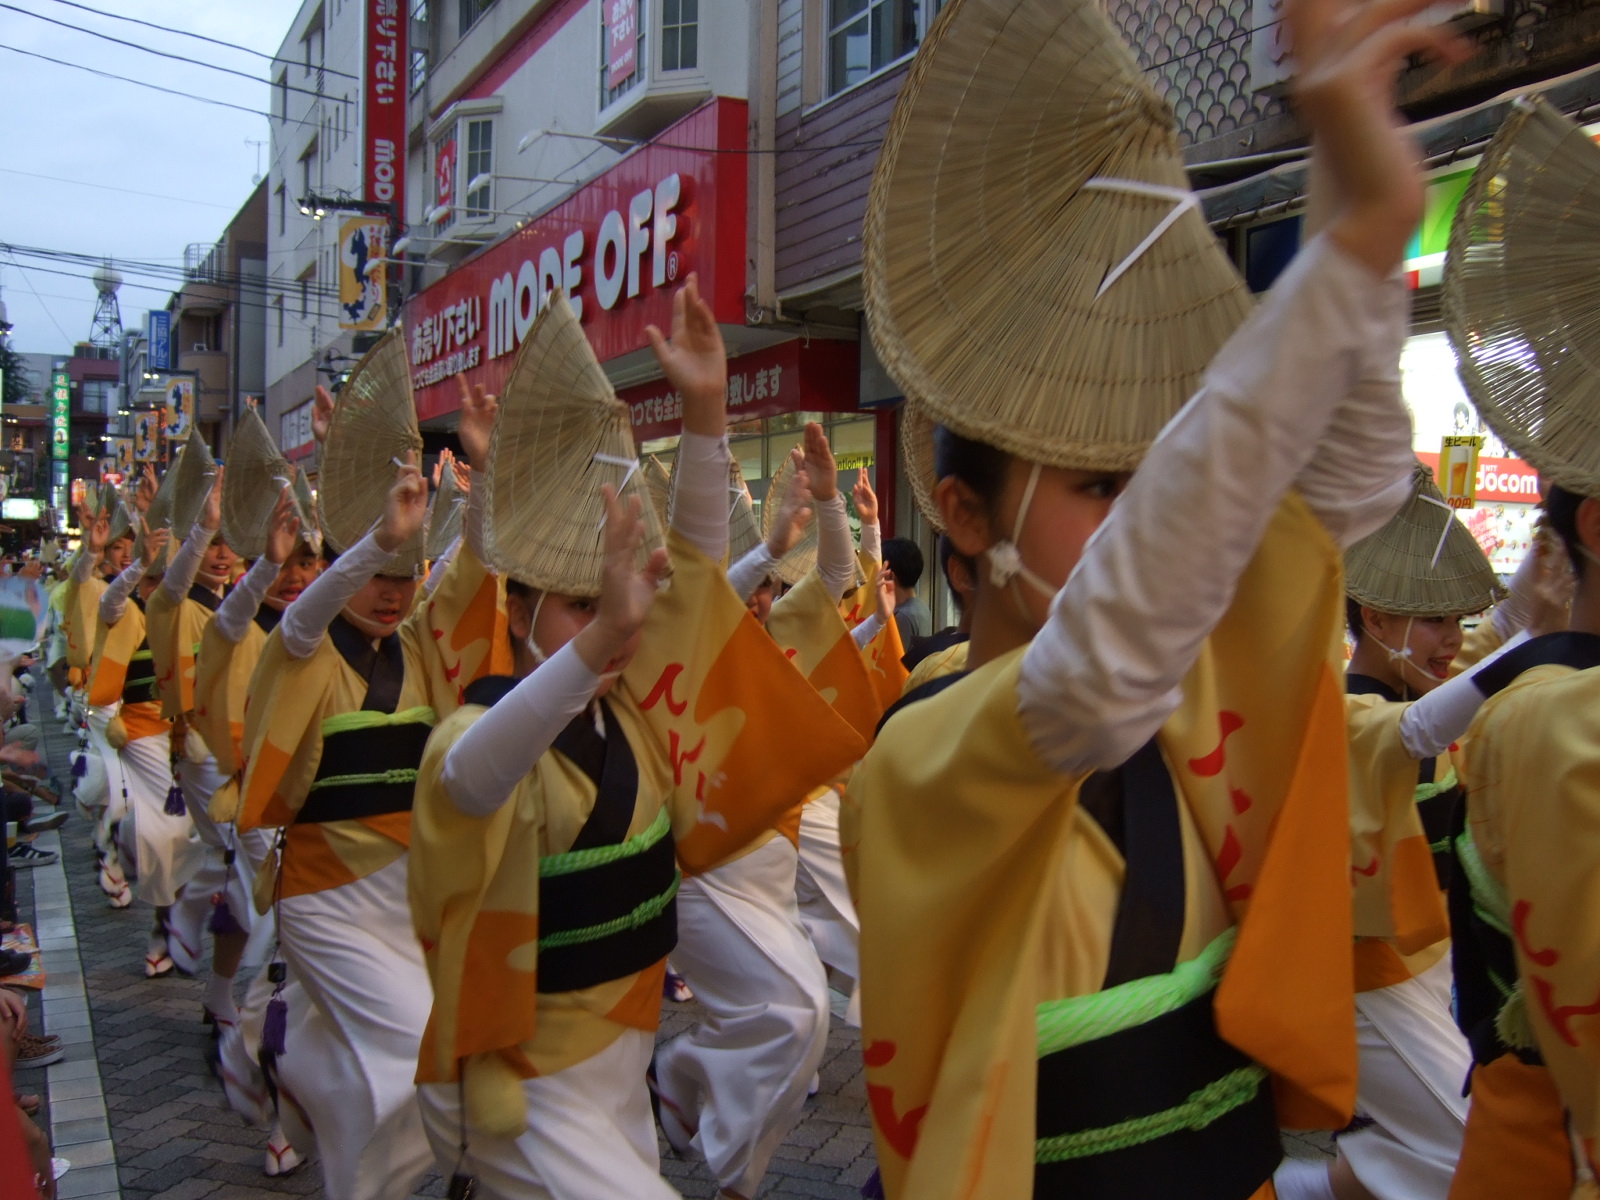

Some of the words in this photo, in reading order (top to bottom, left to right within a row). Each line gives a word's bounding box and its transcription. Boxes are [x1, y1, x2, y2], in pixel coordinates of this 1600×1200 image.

[374, 138, 395, 204] MOD
[488, 229, 585, 360] MODE
[594, 172, 681, 311] OFF
[412, 295, 481, 366] お売り下さい
[725, 364, 782, 406] 致します
[1444, 436, 1477, 448] 生ビール
[1485, 464, 1498, 472] NTT
